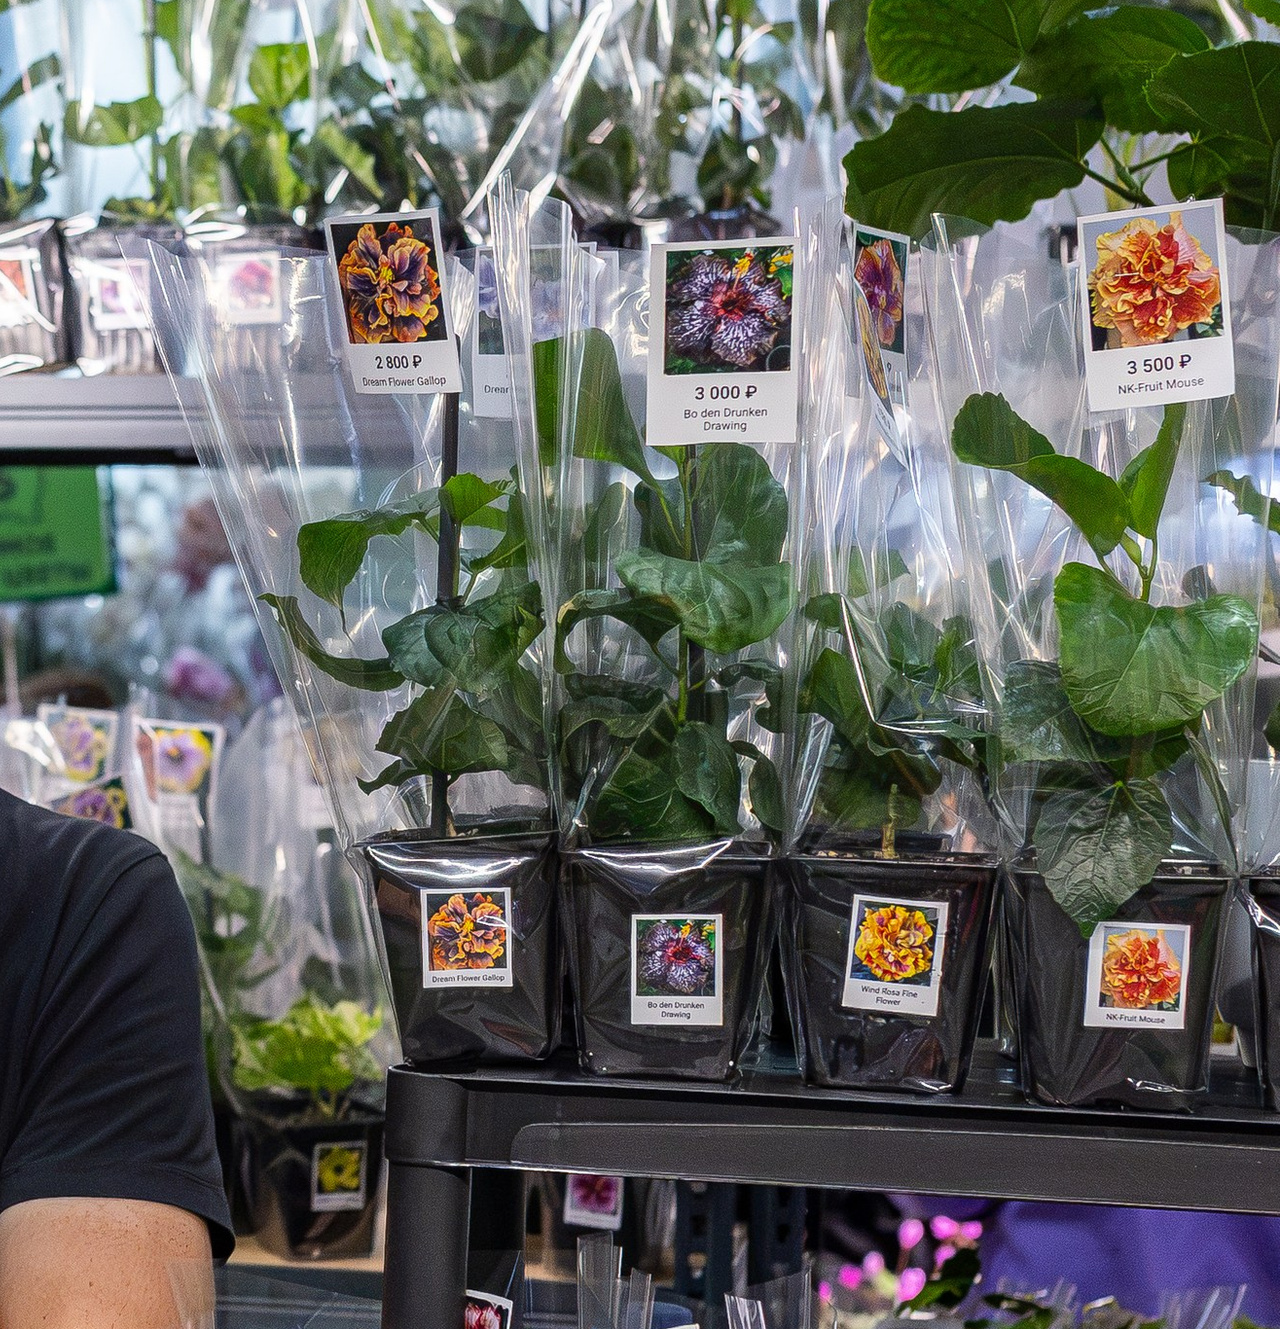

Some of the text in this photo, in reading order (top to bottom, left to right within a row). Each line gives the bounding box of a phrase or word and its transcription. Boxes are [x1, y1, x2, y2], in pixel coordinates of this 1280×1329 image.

[375, 355, 422, 369] 2 800 ₽
[1127, 354, 1191, 375] 3 500 ₽
[362, 376, 446, 387] Dream Flower Gallop
[1118, 377, 1204, 394] NK-Fruit Mouse
[695, 385, 757, 400] 3 000 ₽
[684, 408, 768, 419] Bo den Drunken
[703, 421, 747, 432] Drawing
[432, 974, 505, 983] Dream Flower Gallop
[659, 1001, 673, 1009] den
[674, 1001, 705, 1009] Drunken
[875, 996, 901, 1005] Flower
[661, 1011, 691, 1019] Drawing
